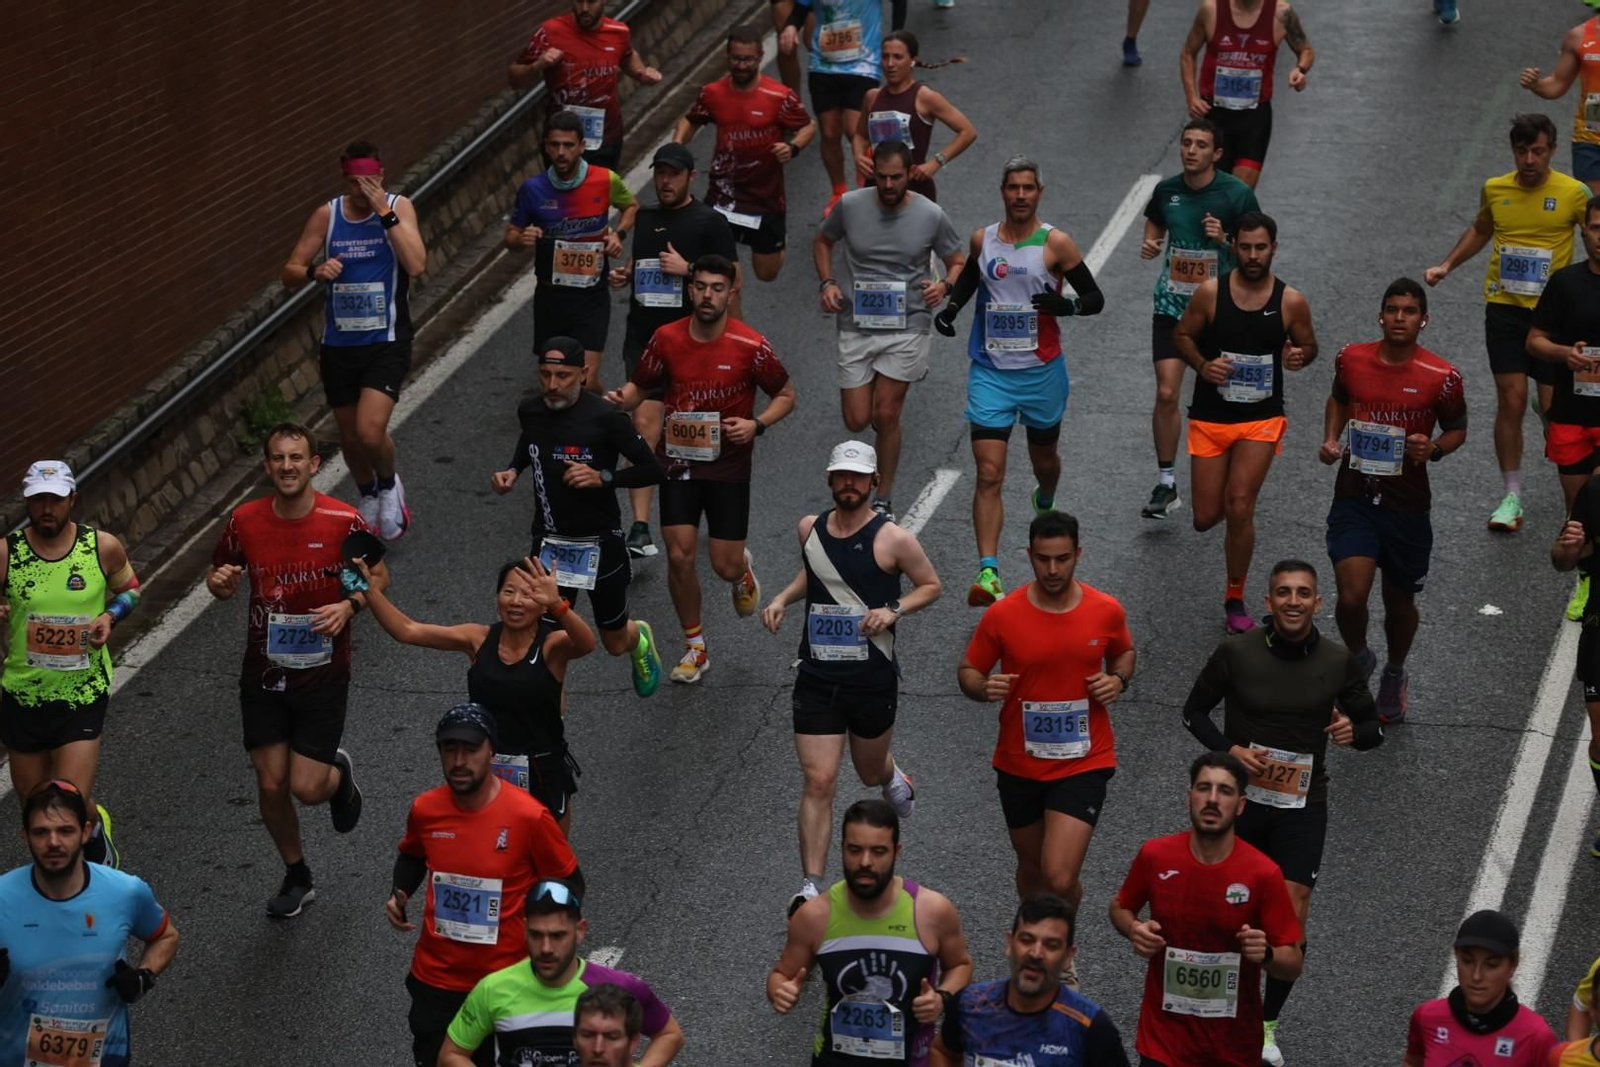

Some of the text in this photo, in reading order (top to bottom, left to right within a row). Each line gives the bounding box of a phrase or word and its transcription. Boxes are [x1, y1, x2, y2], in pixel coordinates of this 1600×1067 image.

[561, 253, 594, 268] 3769
[1506, 258, 1537, 274] 2981
[1175, 261, 1206, 277] 4873
[340, 295, 372, 310] 3324
[861, 293, 892, 308] 2231
[993, 315, 1025, 330] 2395
[1227, 367, 1262, 382] 2453
[672, 423, 706, 439] 6004
[1356, 433, 1391, 453] 2794
[549, 547, 585, 564] 3257
[816, 618, 854, 636] 2203
[35, 628, 76, 646] 5223
[278, 628, 318, 645] 2729
[1033, 715, 1075, 733] 2315
[442, 889, 481, 914] 2521
[1176, 965, 1221, 988] 6560
[41, 1001, 96, 1014] Sanitas
[841, 1005, 886, 1028] 2263
[39, 1032, 88, 1058] 6379
[1039, 1043, 1069, 1055] HOKA
